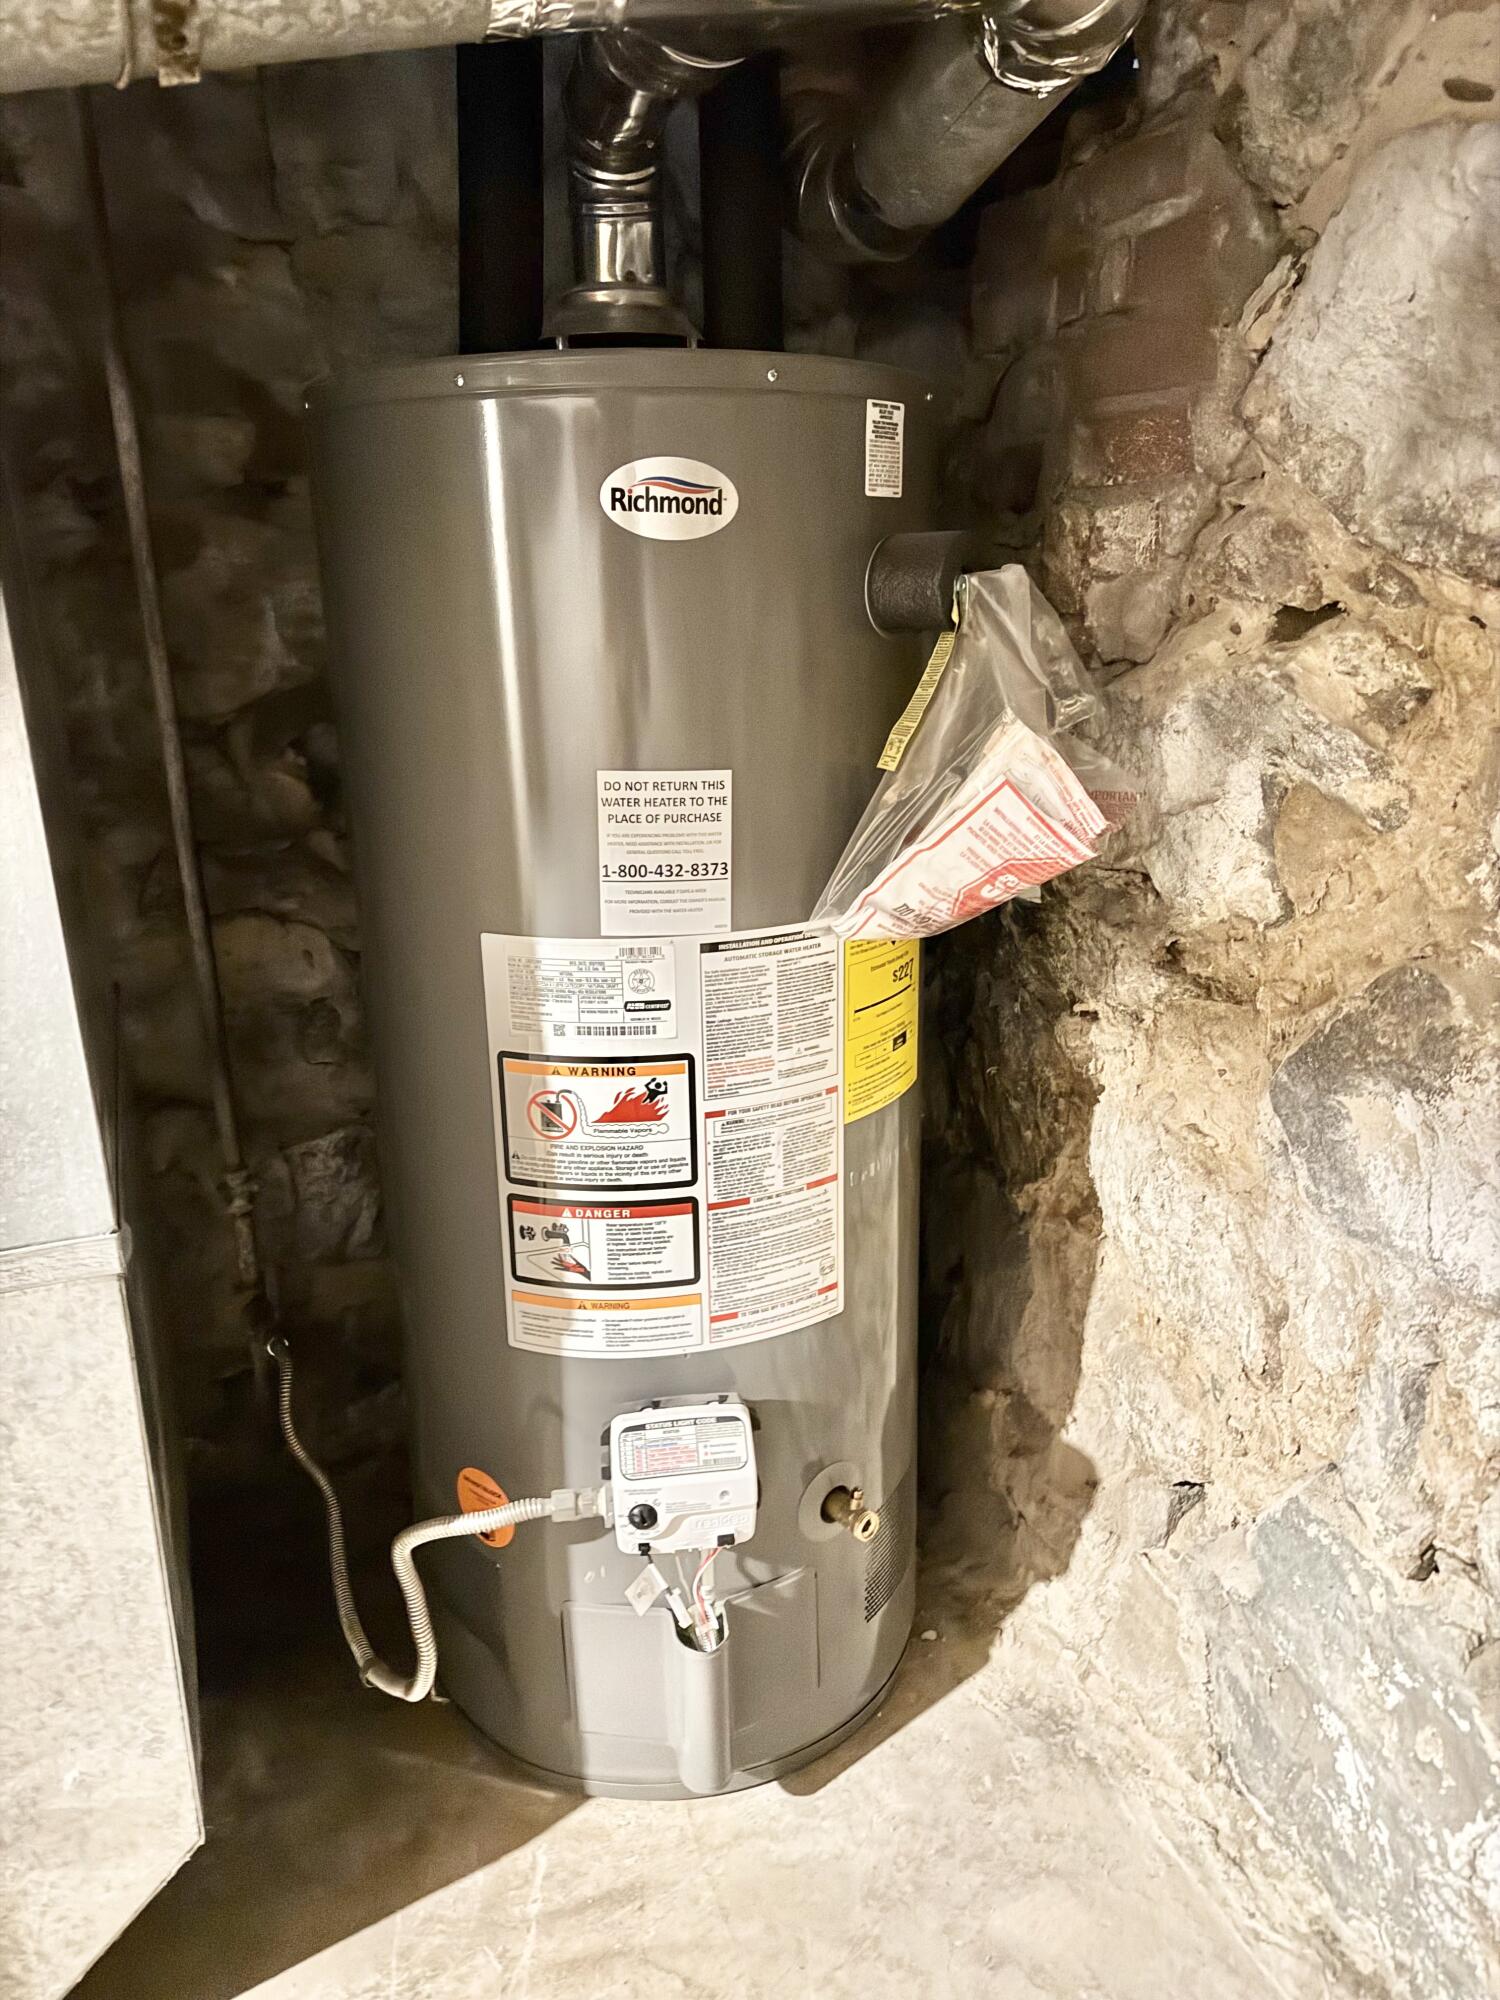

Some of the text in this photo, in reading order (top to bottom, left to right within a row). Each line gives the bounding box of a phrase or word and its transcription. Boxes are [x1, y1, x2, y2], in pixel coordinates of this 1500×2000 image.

[611, 486, 722, 515] Richmond
[604, 780, 725, 791] DO NOT RETURN THIS
[601, 796, 727, 807] WATER HEATER TO THE
[608, 813, 722, 823] PLACE OF PURCHASE
[602, 862, 728, 878] 1-800-432-8373
[568, 1067, 636, 1076] WARNING
[575, 1209, 631, 1218] DANGER
